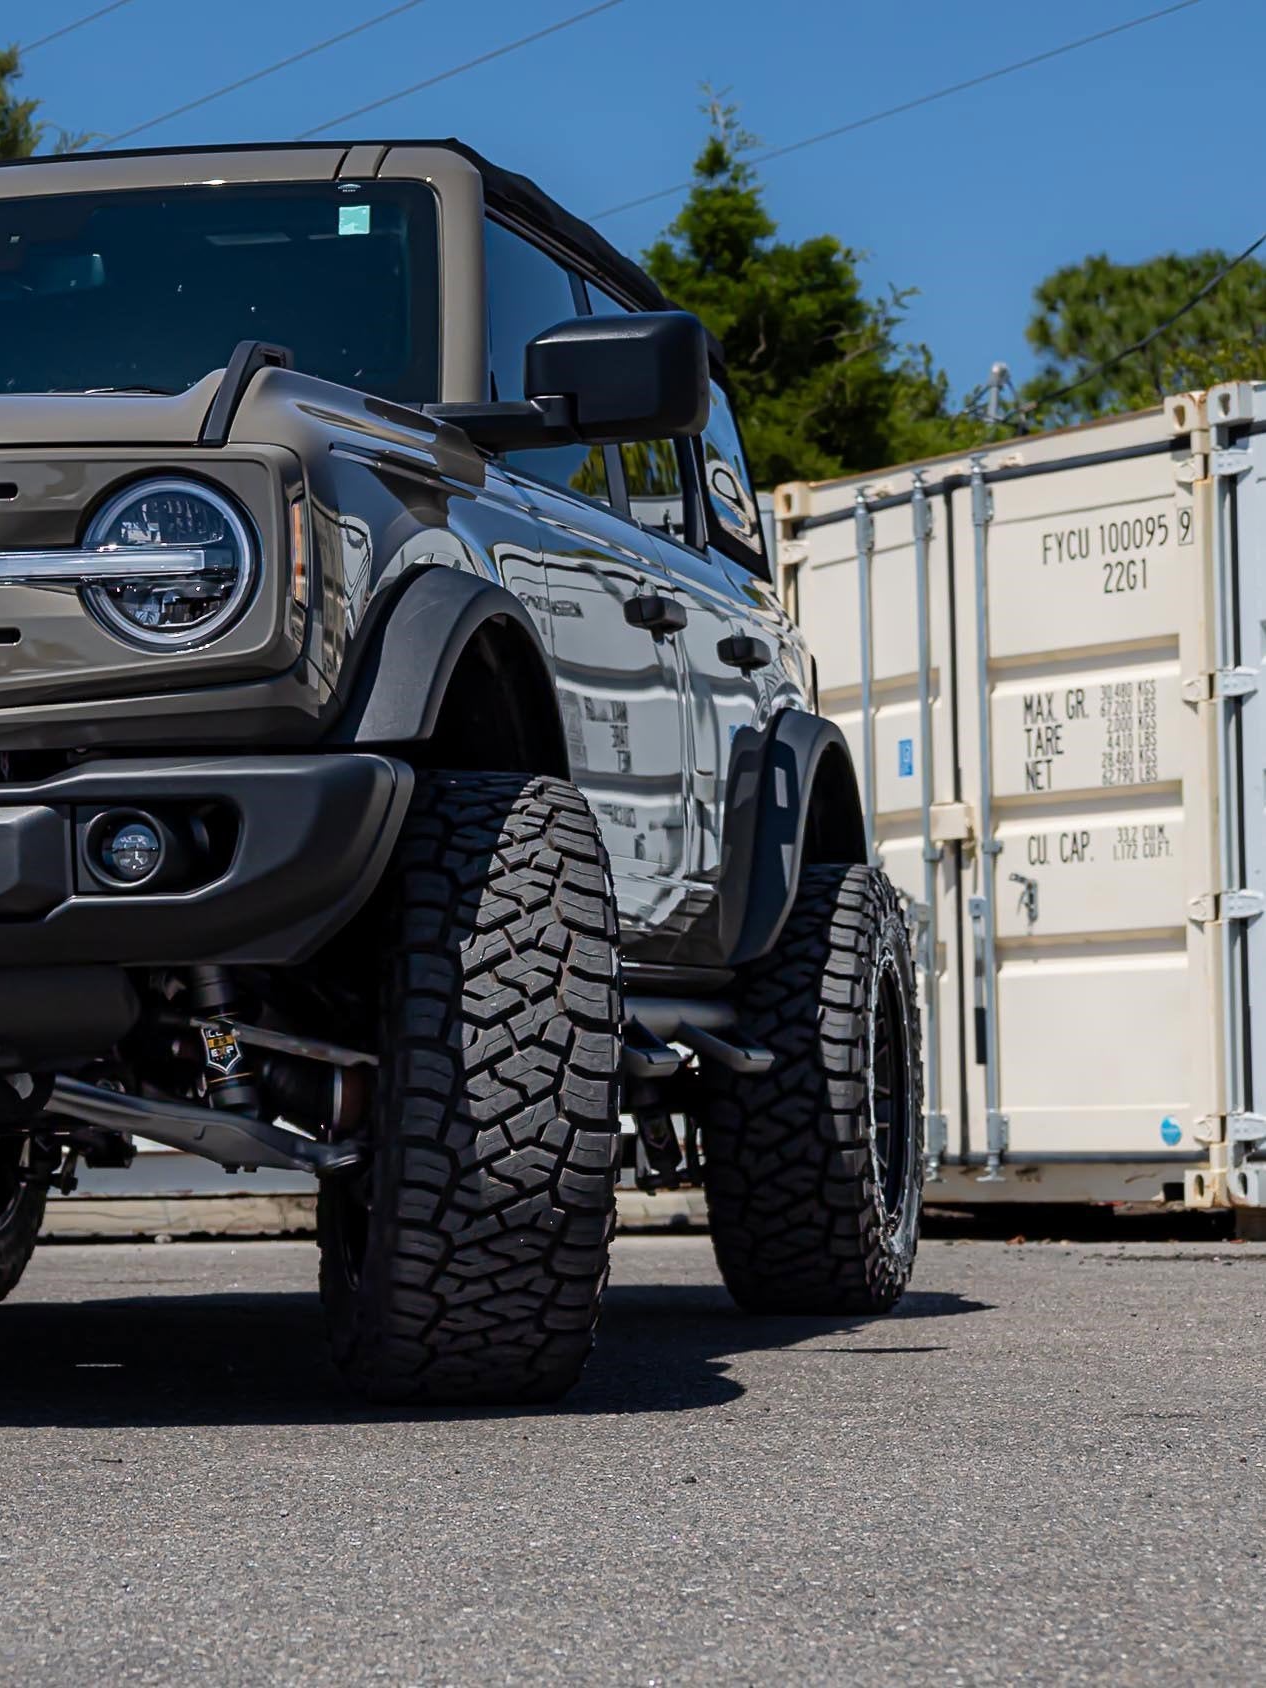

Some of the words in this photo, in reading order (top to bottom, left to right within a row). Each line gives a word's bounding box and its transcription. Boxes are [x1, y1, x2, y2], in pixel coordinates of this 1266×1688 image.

[1042, 527, 1090, 565] FYCU
[1099, 514, 1169, 555] 100095
[1180, 511, 1191, 541] 9
[1103, 558, 1147, 594] 22G1
[1066, 688, 1089, 720] GR.
[1024, 724, 1064, 758] TARE
[1025, 759, 1053, 791] NET
[1060, 831, 1094, 864] CAP.
